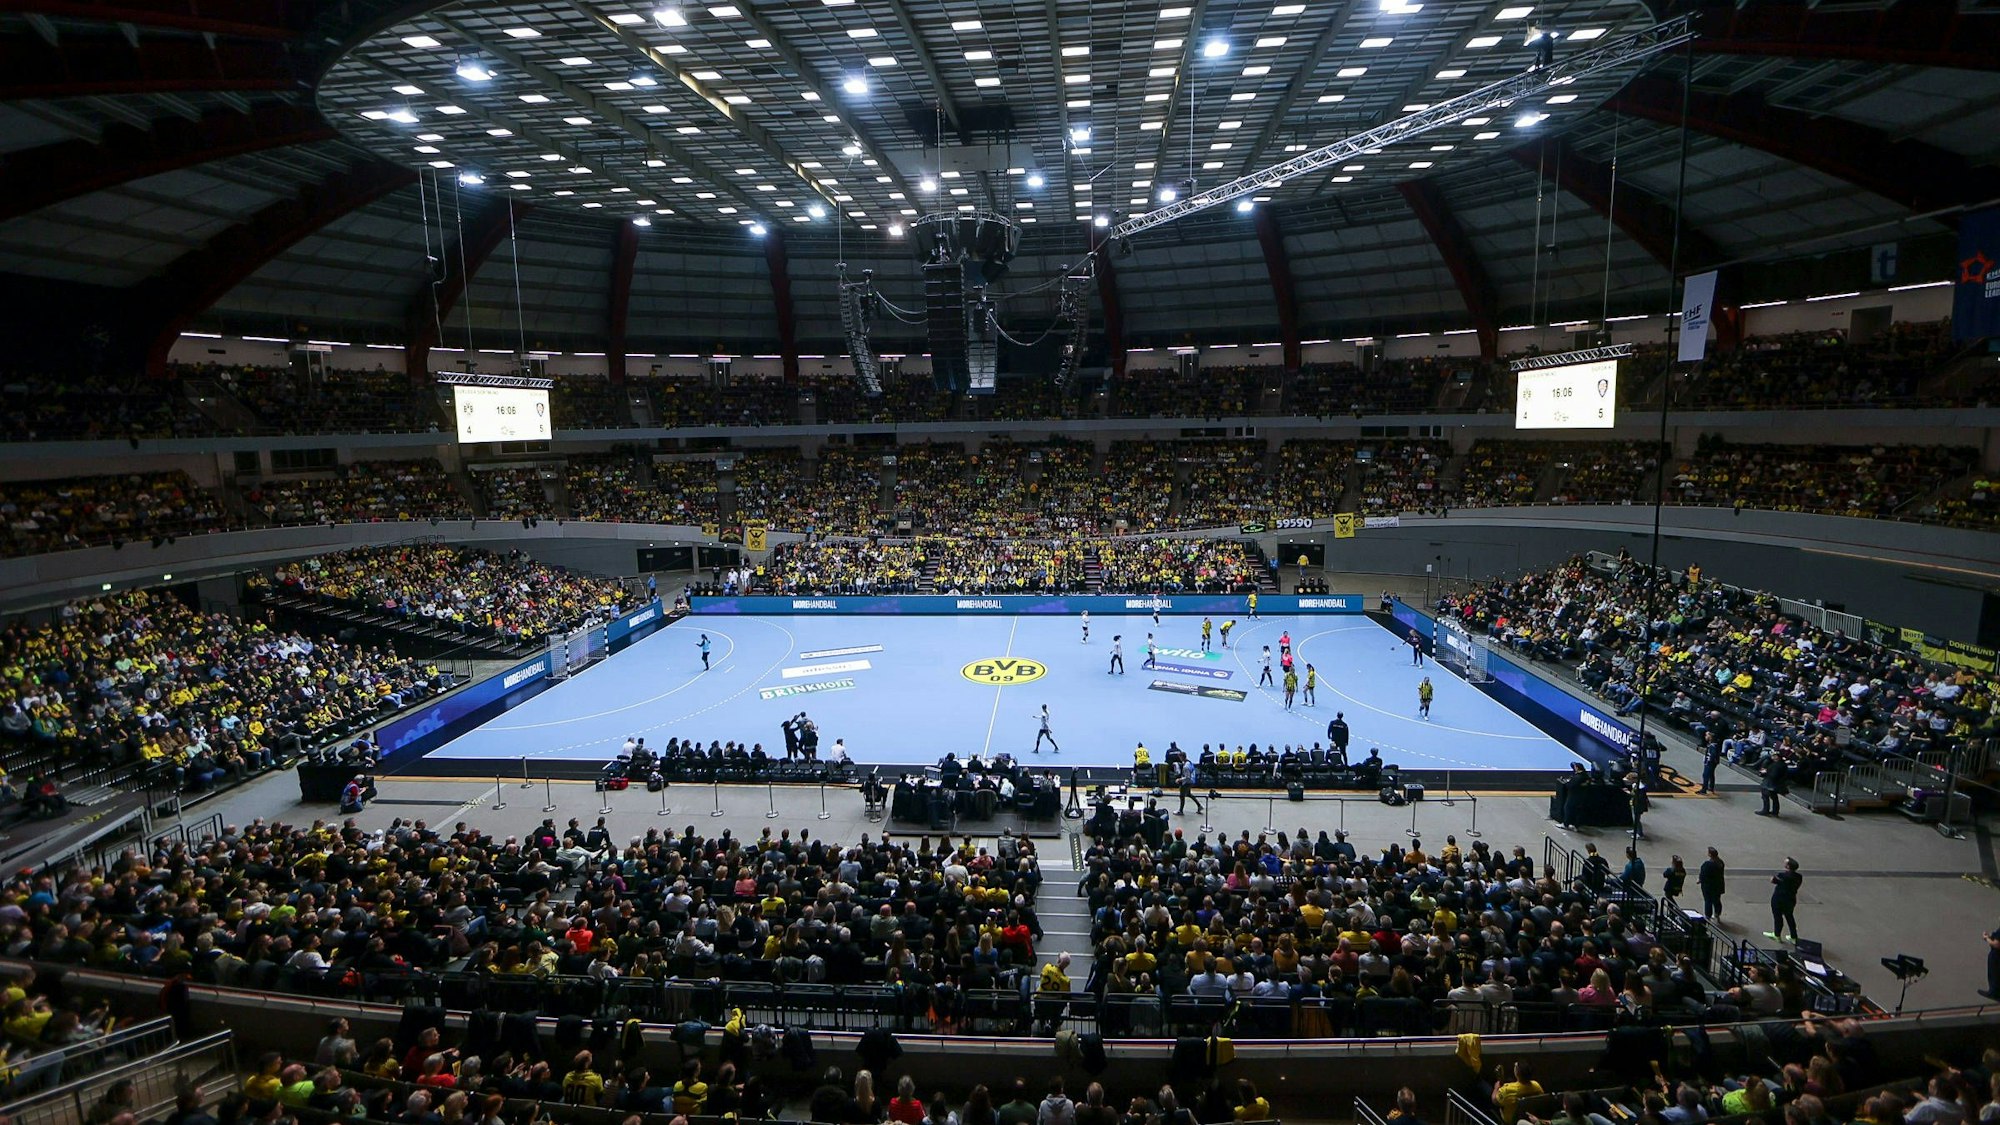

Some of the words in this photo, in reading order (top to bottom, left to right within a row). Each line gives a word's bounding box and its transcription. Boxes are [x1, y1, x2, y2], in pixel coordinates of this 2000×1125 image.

[1683, 304, 1702, 320] EHF
[1552, 386, 1573, 398] 16:06
[496, 406, 517, 415] 16:06
[1522, 411, 1528, 420] 4
[1598, 407, 1604, 419] 5
[466, 425, 472, 434] 4
[539, 424, 544, 433] 5
[1276, 518, 1312, 528] 59590
[792, 600, 838, 610] MOREHANDBALL
[956, 599, 1002, 610] MOREHANDBALL
[1298, 599, 1346, 609] MOREHANDBALL
[628, 608, 655, 628] MOREHANDBALL
[1949, 640, 1995, 657] DORTMUND
[973, 660, 1037, 676] BVB
[503, 660, 545, 689] MOREHANDBALL
[1137, 750, 1148, 758] 30
